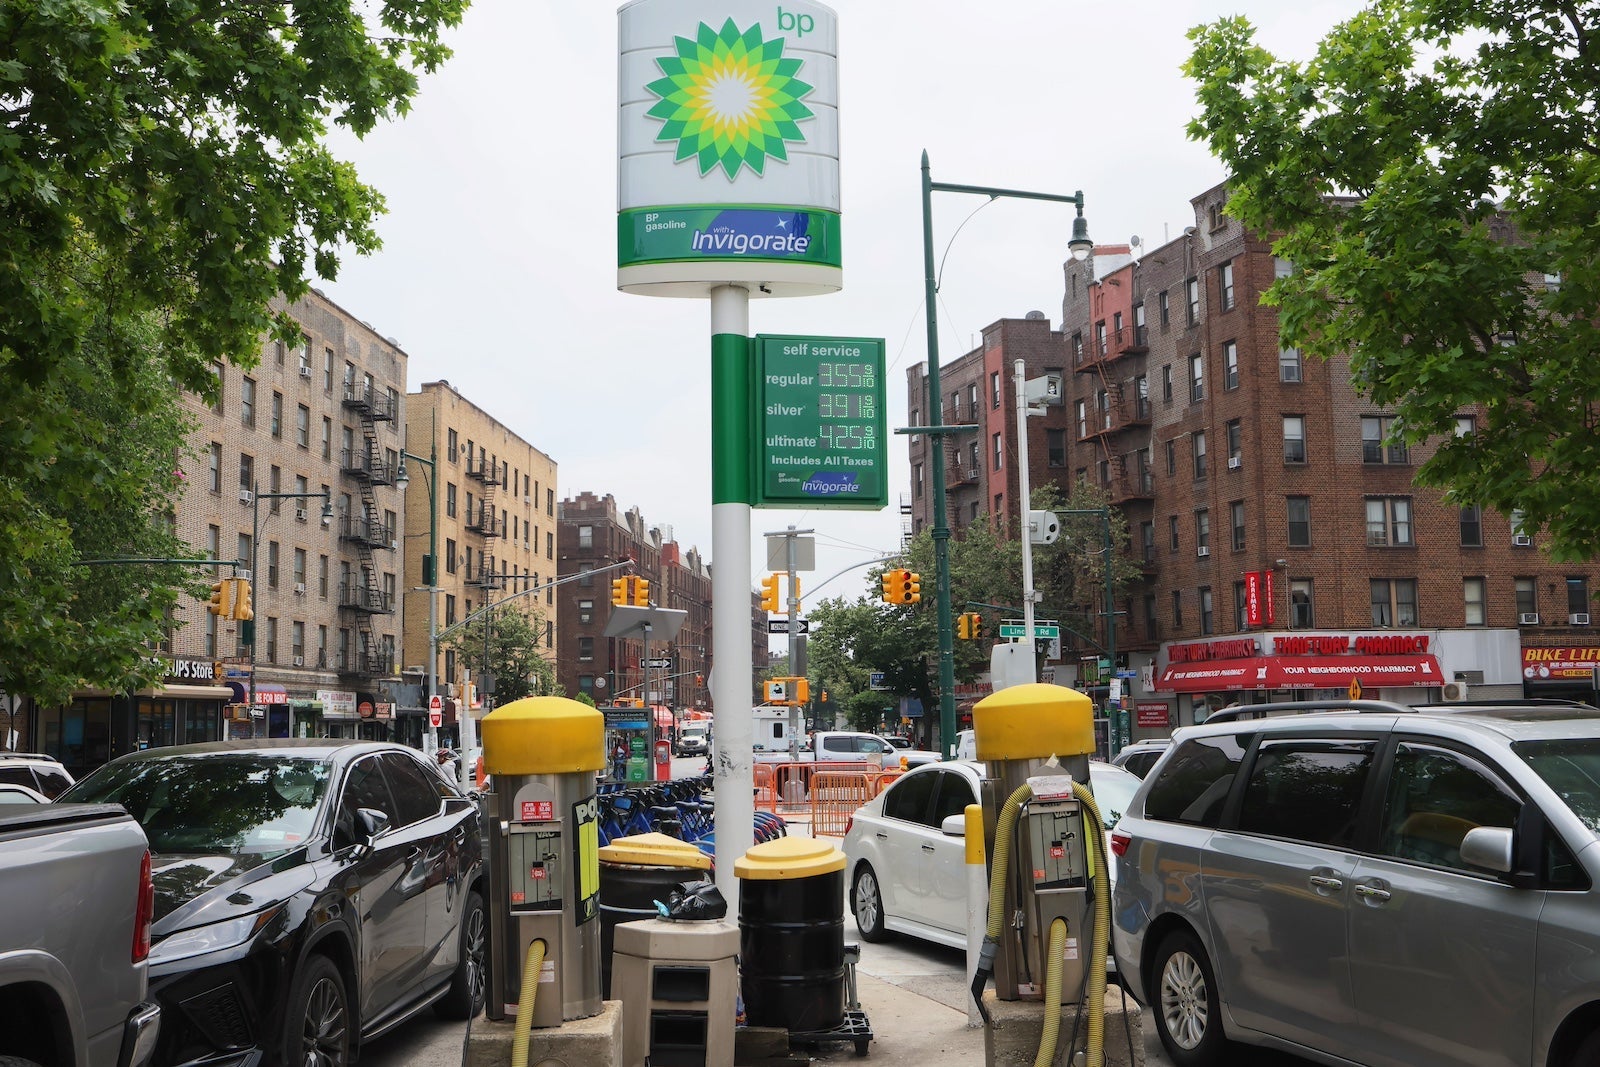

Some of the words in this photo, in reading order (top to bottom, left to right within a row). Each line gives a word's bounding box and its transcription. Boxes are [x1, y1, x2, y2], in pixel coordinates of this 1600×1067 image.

[778, 6, 815, 37] bp
[645, 213, 659, 223] BP
[645, 220, 687, 233] gasoline
[713, 225, 729, 235] with
[692, 229, 808, 254] Invigorate
[783, 343, 808, 355] self
[811, 345, 861, 357] service
[766, 373, 814, 387] regular
[766, 403, 803, 416] silver
[766, 434, 817, 448] ultimate
[771, 455, 821, 465] Includes
[823, 456, 840, 465] All
[842, 456, 874, 466] Taxes
[801, 480, 859, 494] Invigorate
[1209, 639, 1256, 659] PHARMACY
[1355, 635, 1429, 654] PHARMACY
[1525, 648, 1567, 662] BIKE
[172, 659, 190, 678] UPS
[191, 661, 213, 679] Store
[1308, 665, 1371, 674] NEIGHBORHOOD
[1373, 665, 1416, 673] PHARMACY
[263, 692, 273, 704] FOR
[273, 692, 286, 704] RENT
[537, 831, 555, 839] VAC
